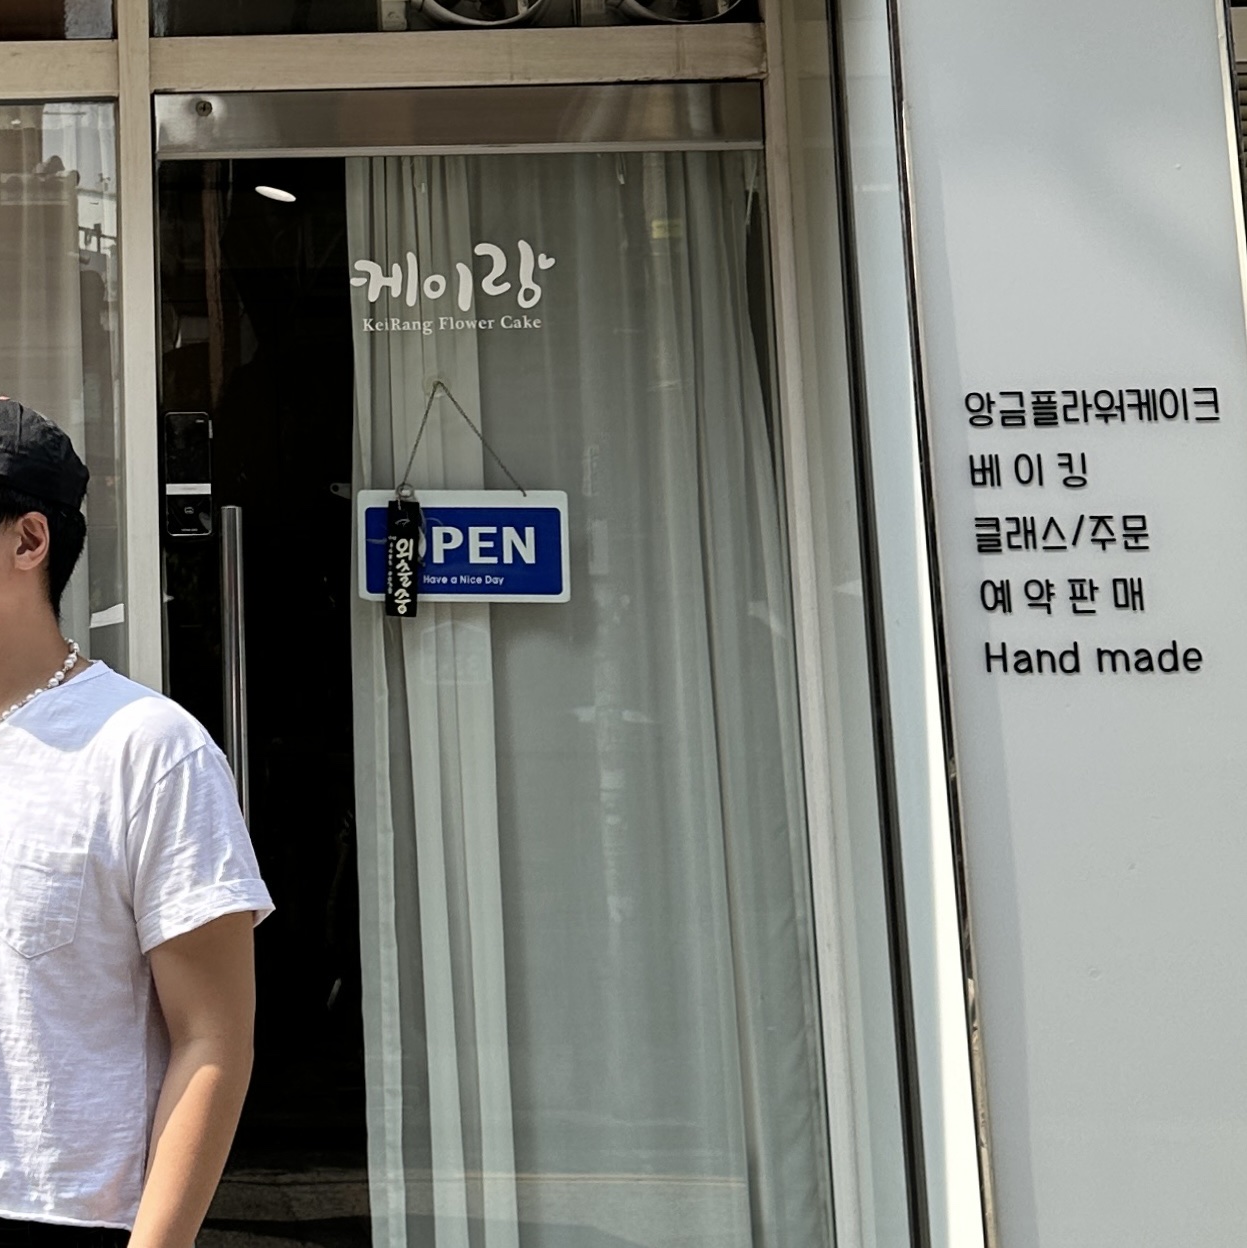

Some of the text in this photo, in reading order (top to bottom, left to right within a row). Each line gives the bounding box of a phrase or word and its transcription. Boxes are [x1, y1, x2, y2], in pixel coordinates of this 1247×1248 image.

[350, 239, 556, 314] 케이랑
[362, 315, 542, 335] KeiRang Flower Cake
[964, 387, 1220, 427] 앙금플라워케이크
[418, 526, 536, 564] PEN
[974, 514, 1150, 553] 클래스/주문
[394, 538, 414, 615] 외출중
[423, 574, 505, 586] Have a Nice Day
[985, 640, 1204, 674] Hand made
